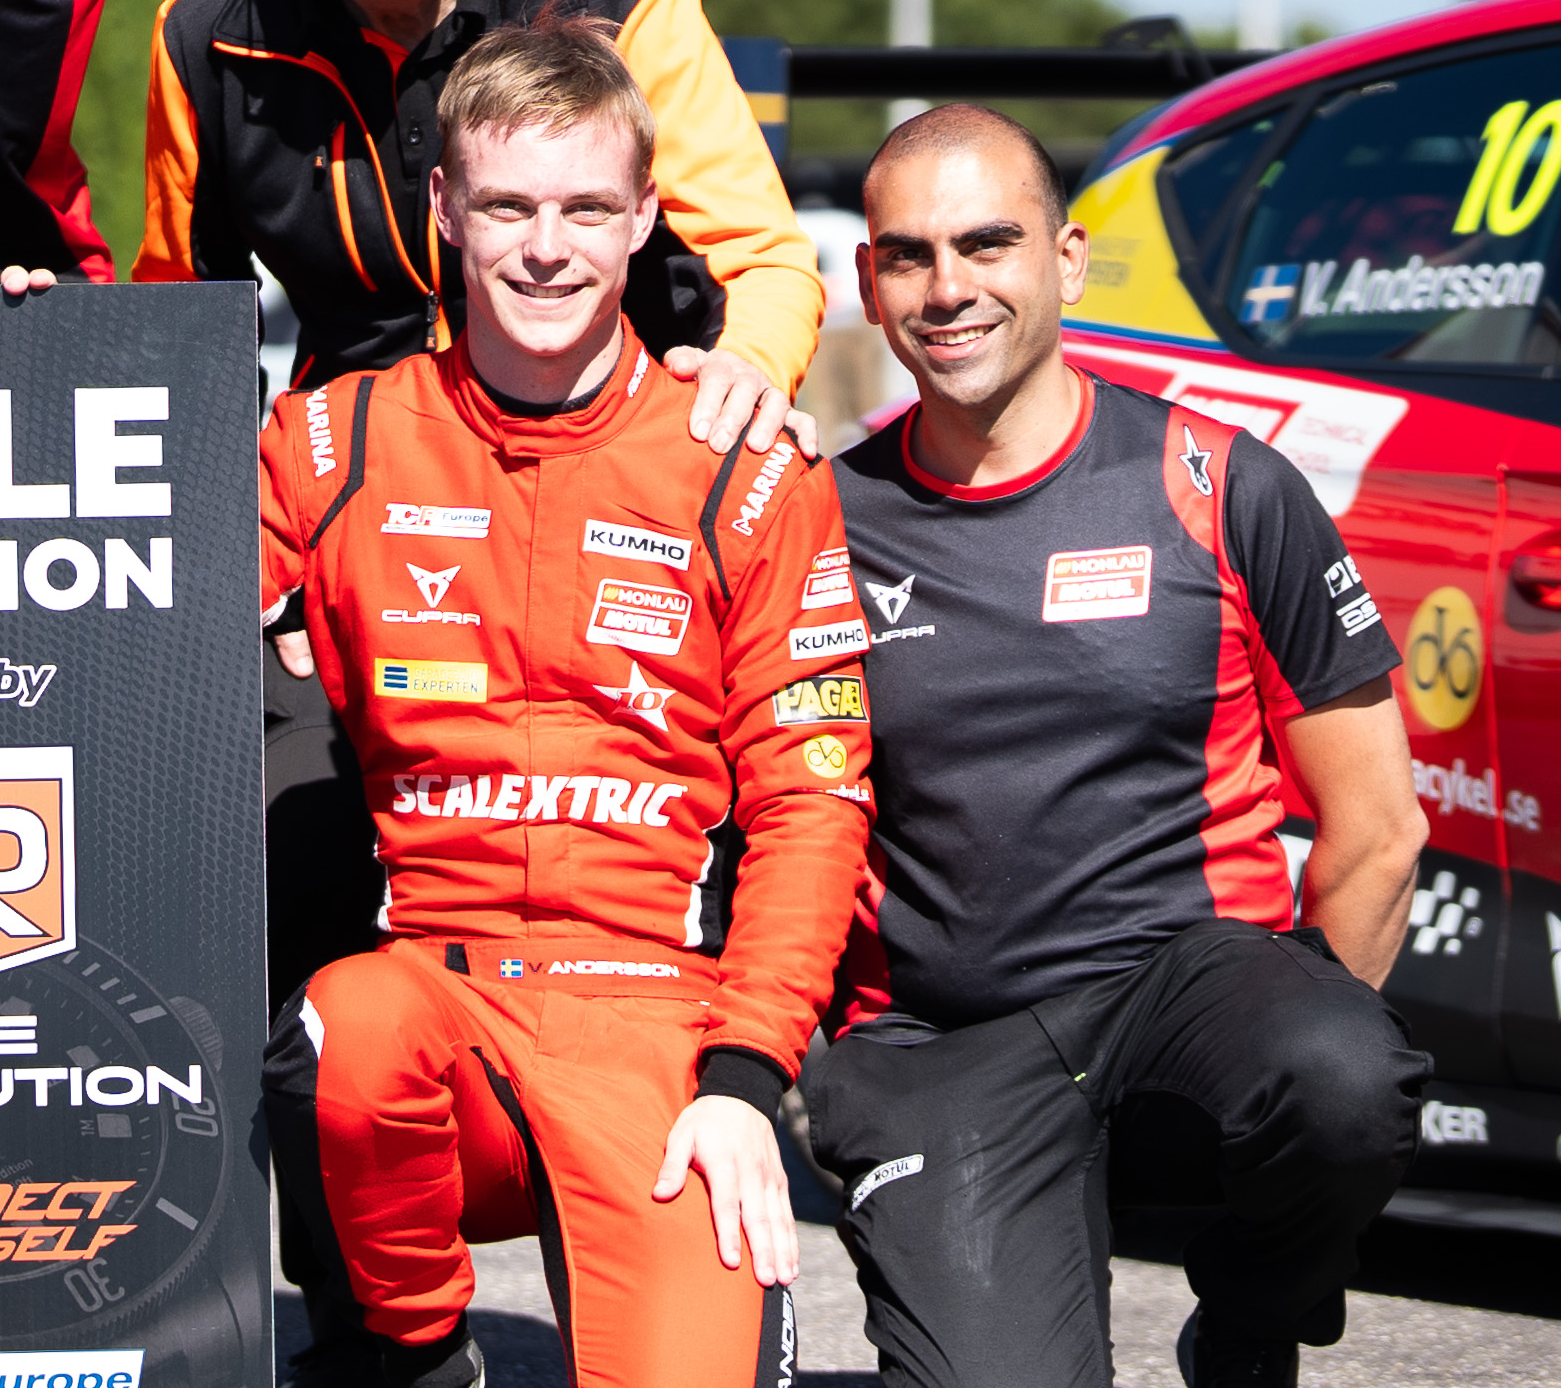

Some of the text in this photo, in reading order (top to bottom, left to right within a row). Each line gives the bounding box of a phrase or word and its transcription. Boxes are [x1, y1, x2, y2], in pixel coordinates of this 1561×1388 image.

[1332, 255, 1543, 316] Andersson
[732, 441, 797, 536] MARINA
[590, 529, 685, 561] KUMHO
[1071, 554, 1144, 574] MONLAU
[618, 588, 686, 612] MONLAU
[1059, 578, 1136, 602] MOTUL
[381, 609, 481, 626] CUPRA
[602, 610, 672, 637] MOTUL
[795, 629, 864, 651] KUMHO
[870, 624, 936, 644] UPRA
[413, 678, 478, 694] EXPERTEN
[616, 690, 664, 711] 10
[393, 773, 687, 828] SCALEXTRIC
[548, 960, 681, 978] ANDERSSON
